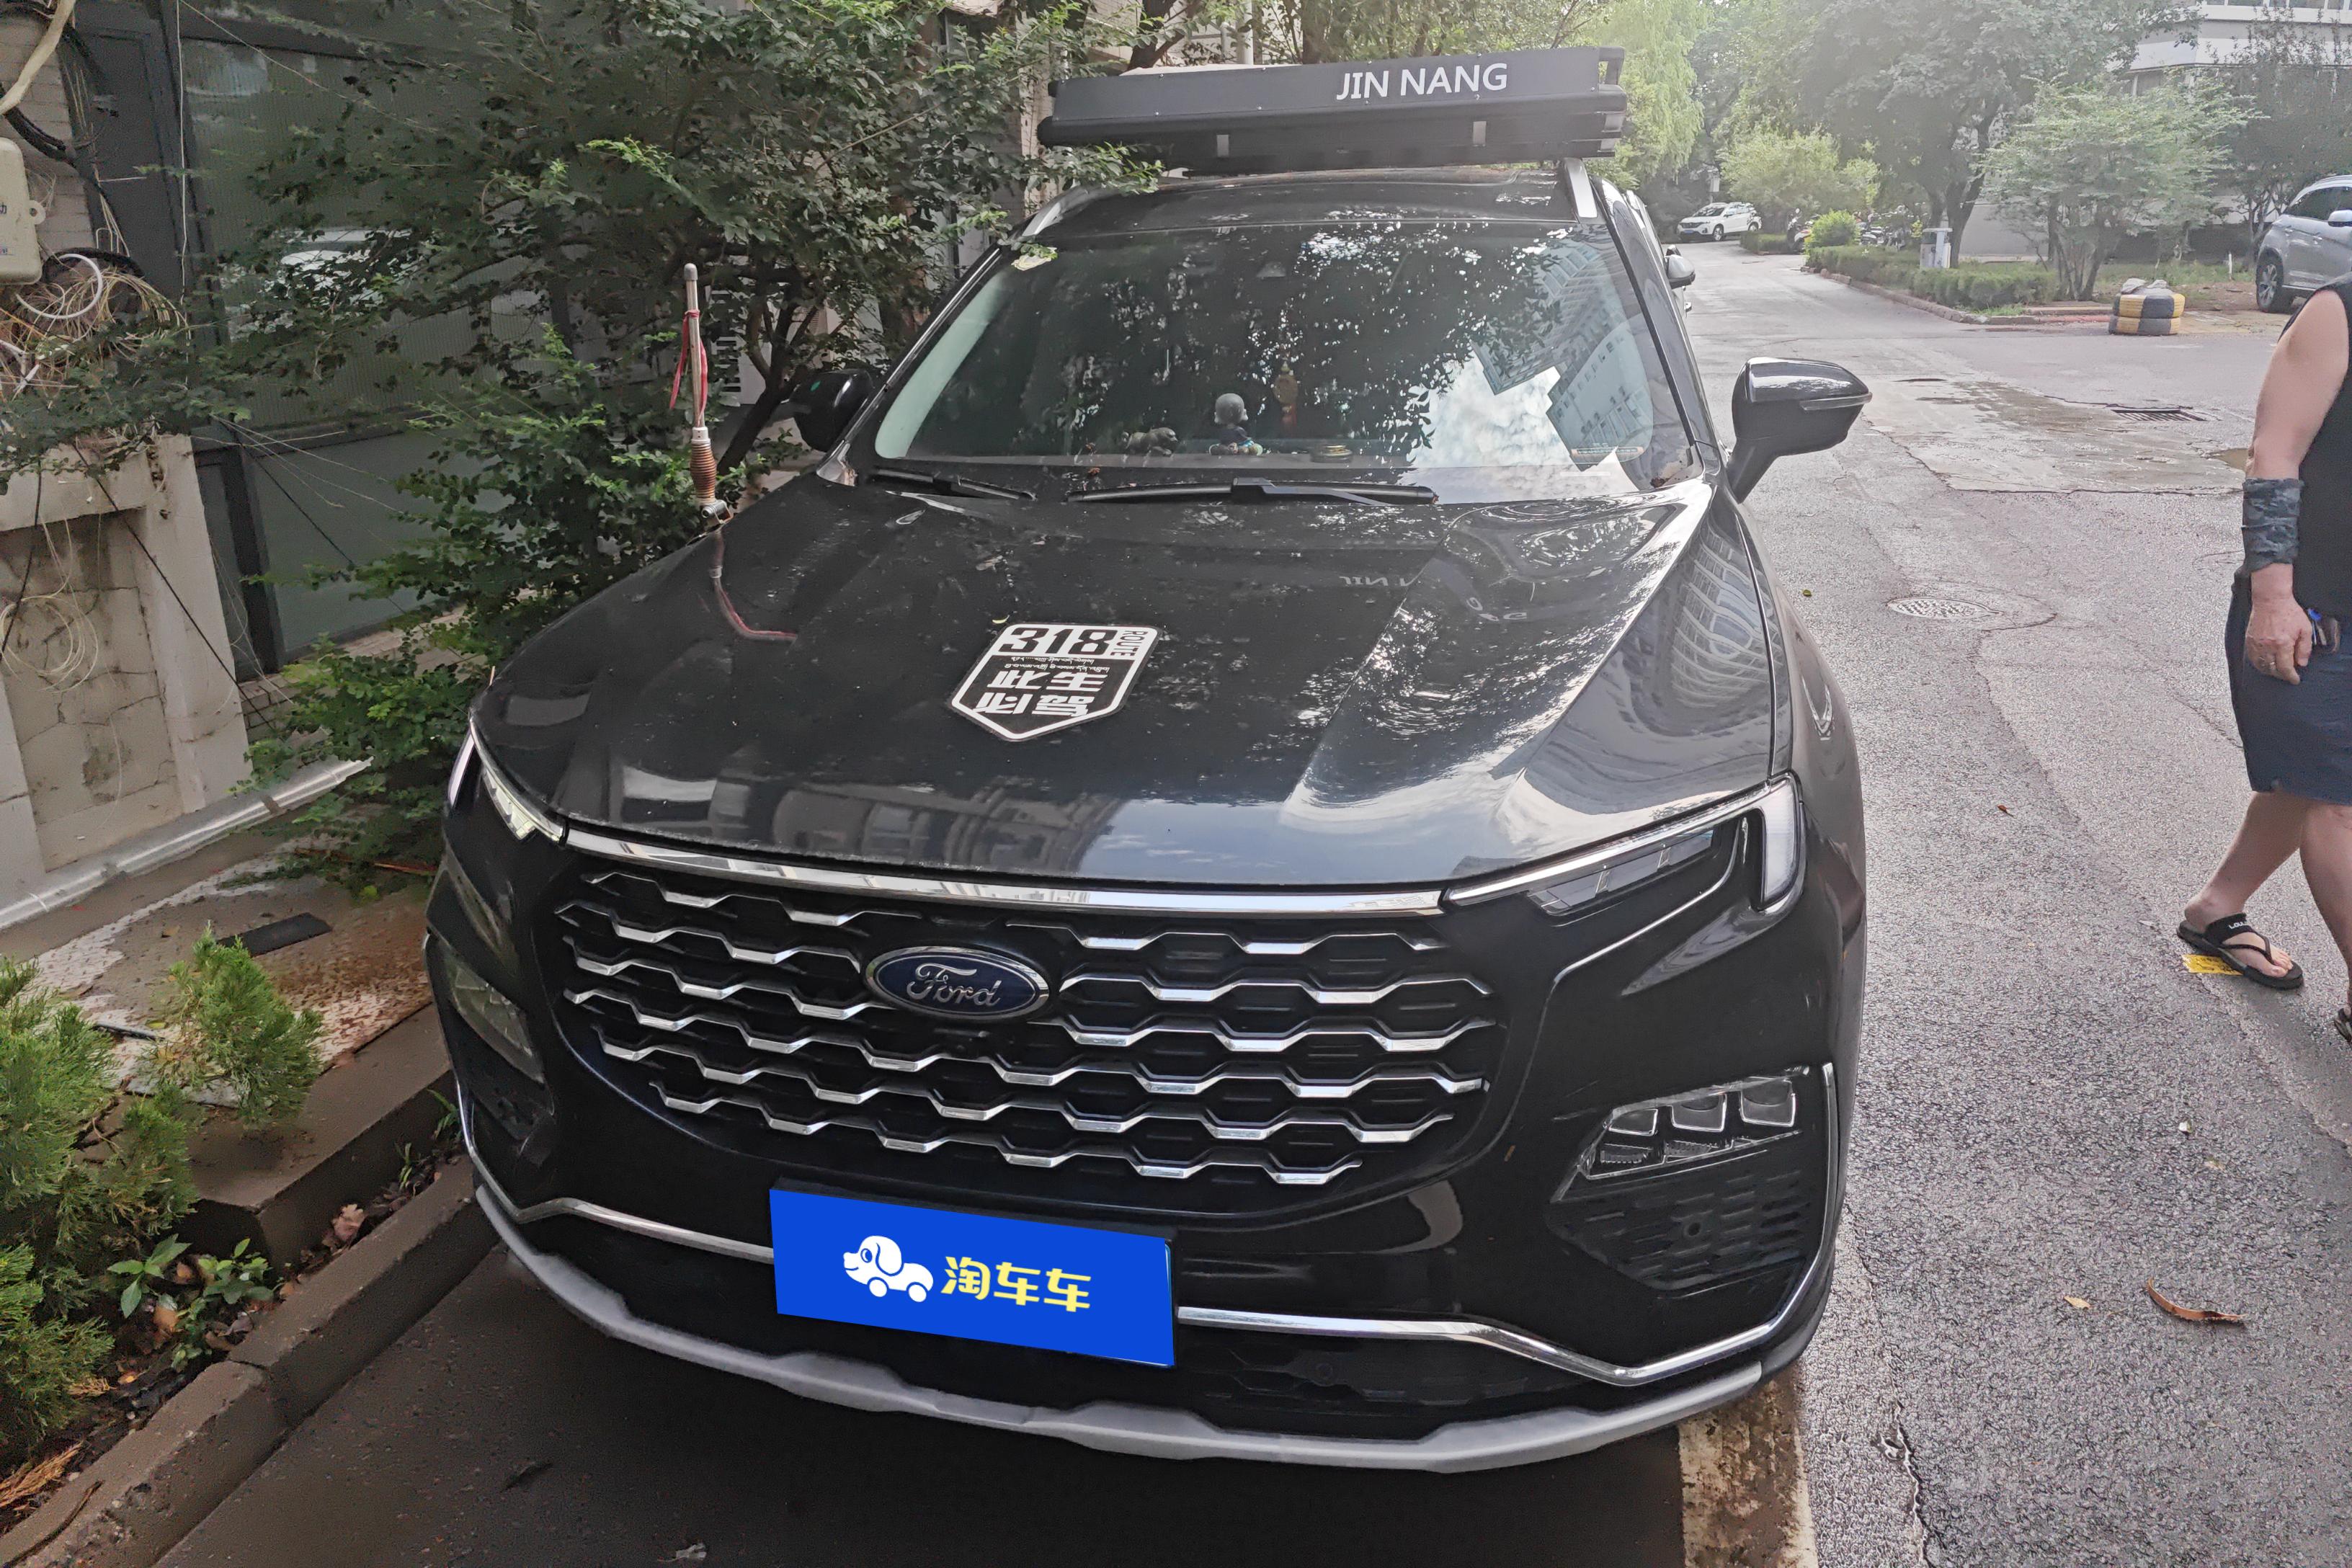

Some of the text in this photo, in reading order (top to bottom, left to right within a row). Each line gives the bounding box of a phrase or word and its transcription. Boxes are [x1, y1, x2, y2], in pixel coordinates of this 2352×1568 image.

[1336, 63, 1507, 100] JIN NANG
[997, 626, 1118, 655] 318
[1110, 630, 1149, 656] ROUTE
[986, 669, 1108, 692] 此生
[906, 963, 1002, 1007] Ford
